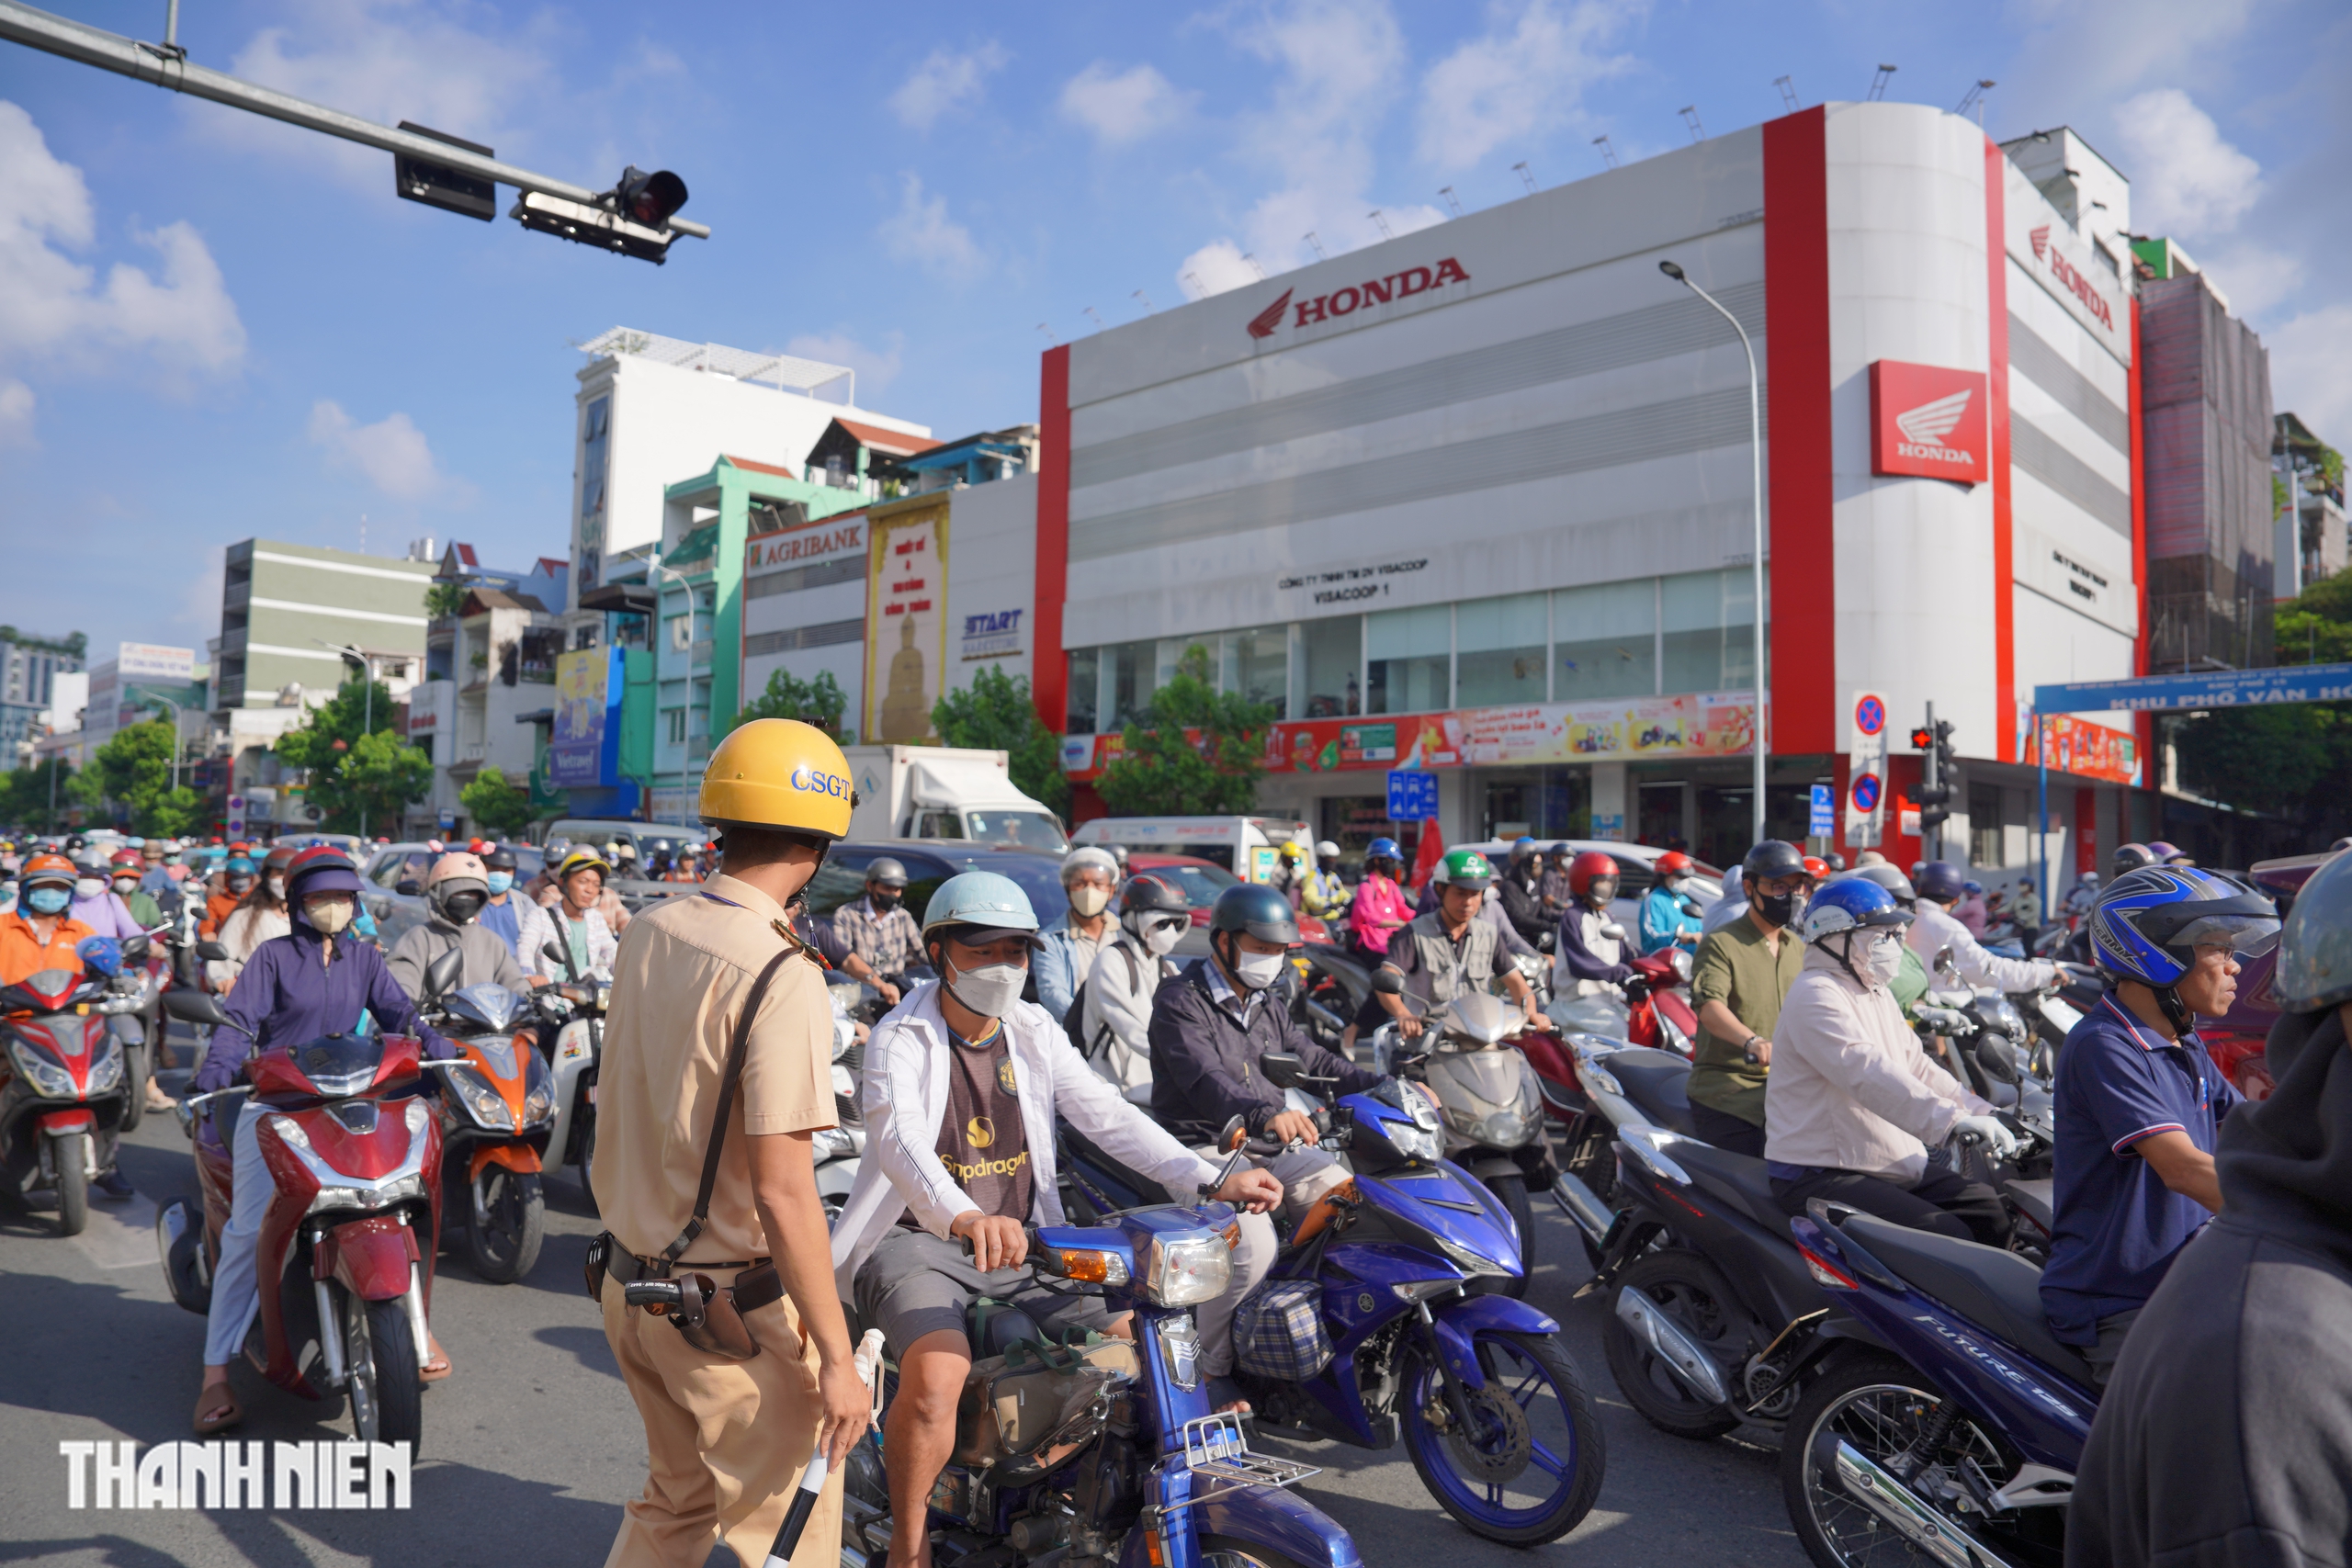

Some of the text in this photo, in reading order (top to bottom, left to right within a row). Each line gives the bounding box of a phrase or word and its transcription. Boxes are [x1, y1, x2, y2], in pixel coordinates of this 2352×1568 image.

[1295, 257, 1471, 328] HONDA
[2051, 245, 2113, 333] HONDA
[1897, 443, 1973, 464] HONDA
[766, 525, 862, 564] AGRIBANK
[1377, 558, 1429, 575] VISACOOP
[1314, 583, 1389, 604] VISACOOP 1
[965, 609, 1023, 633] START
[2110, 697, 2167, 710] KHU
[2177, 688, 2237, 707] PHỐ
[2246, 687, 2306, 703] VĂN
[557, 750, 594, 770] Vietravel
[791, 769, 851, 801] CSGT
[940, 1151, 1030, 1184] Snpdrag
[1913, 1315, 2078, 1417] FUTURE 125
